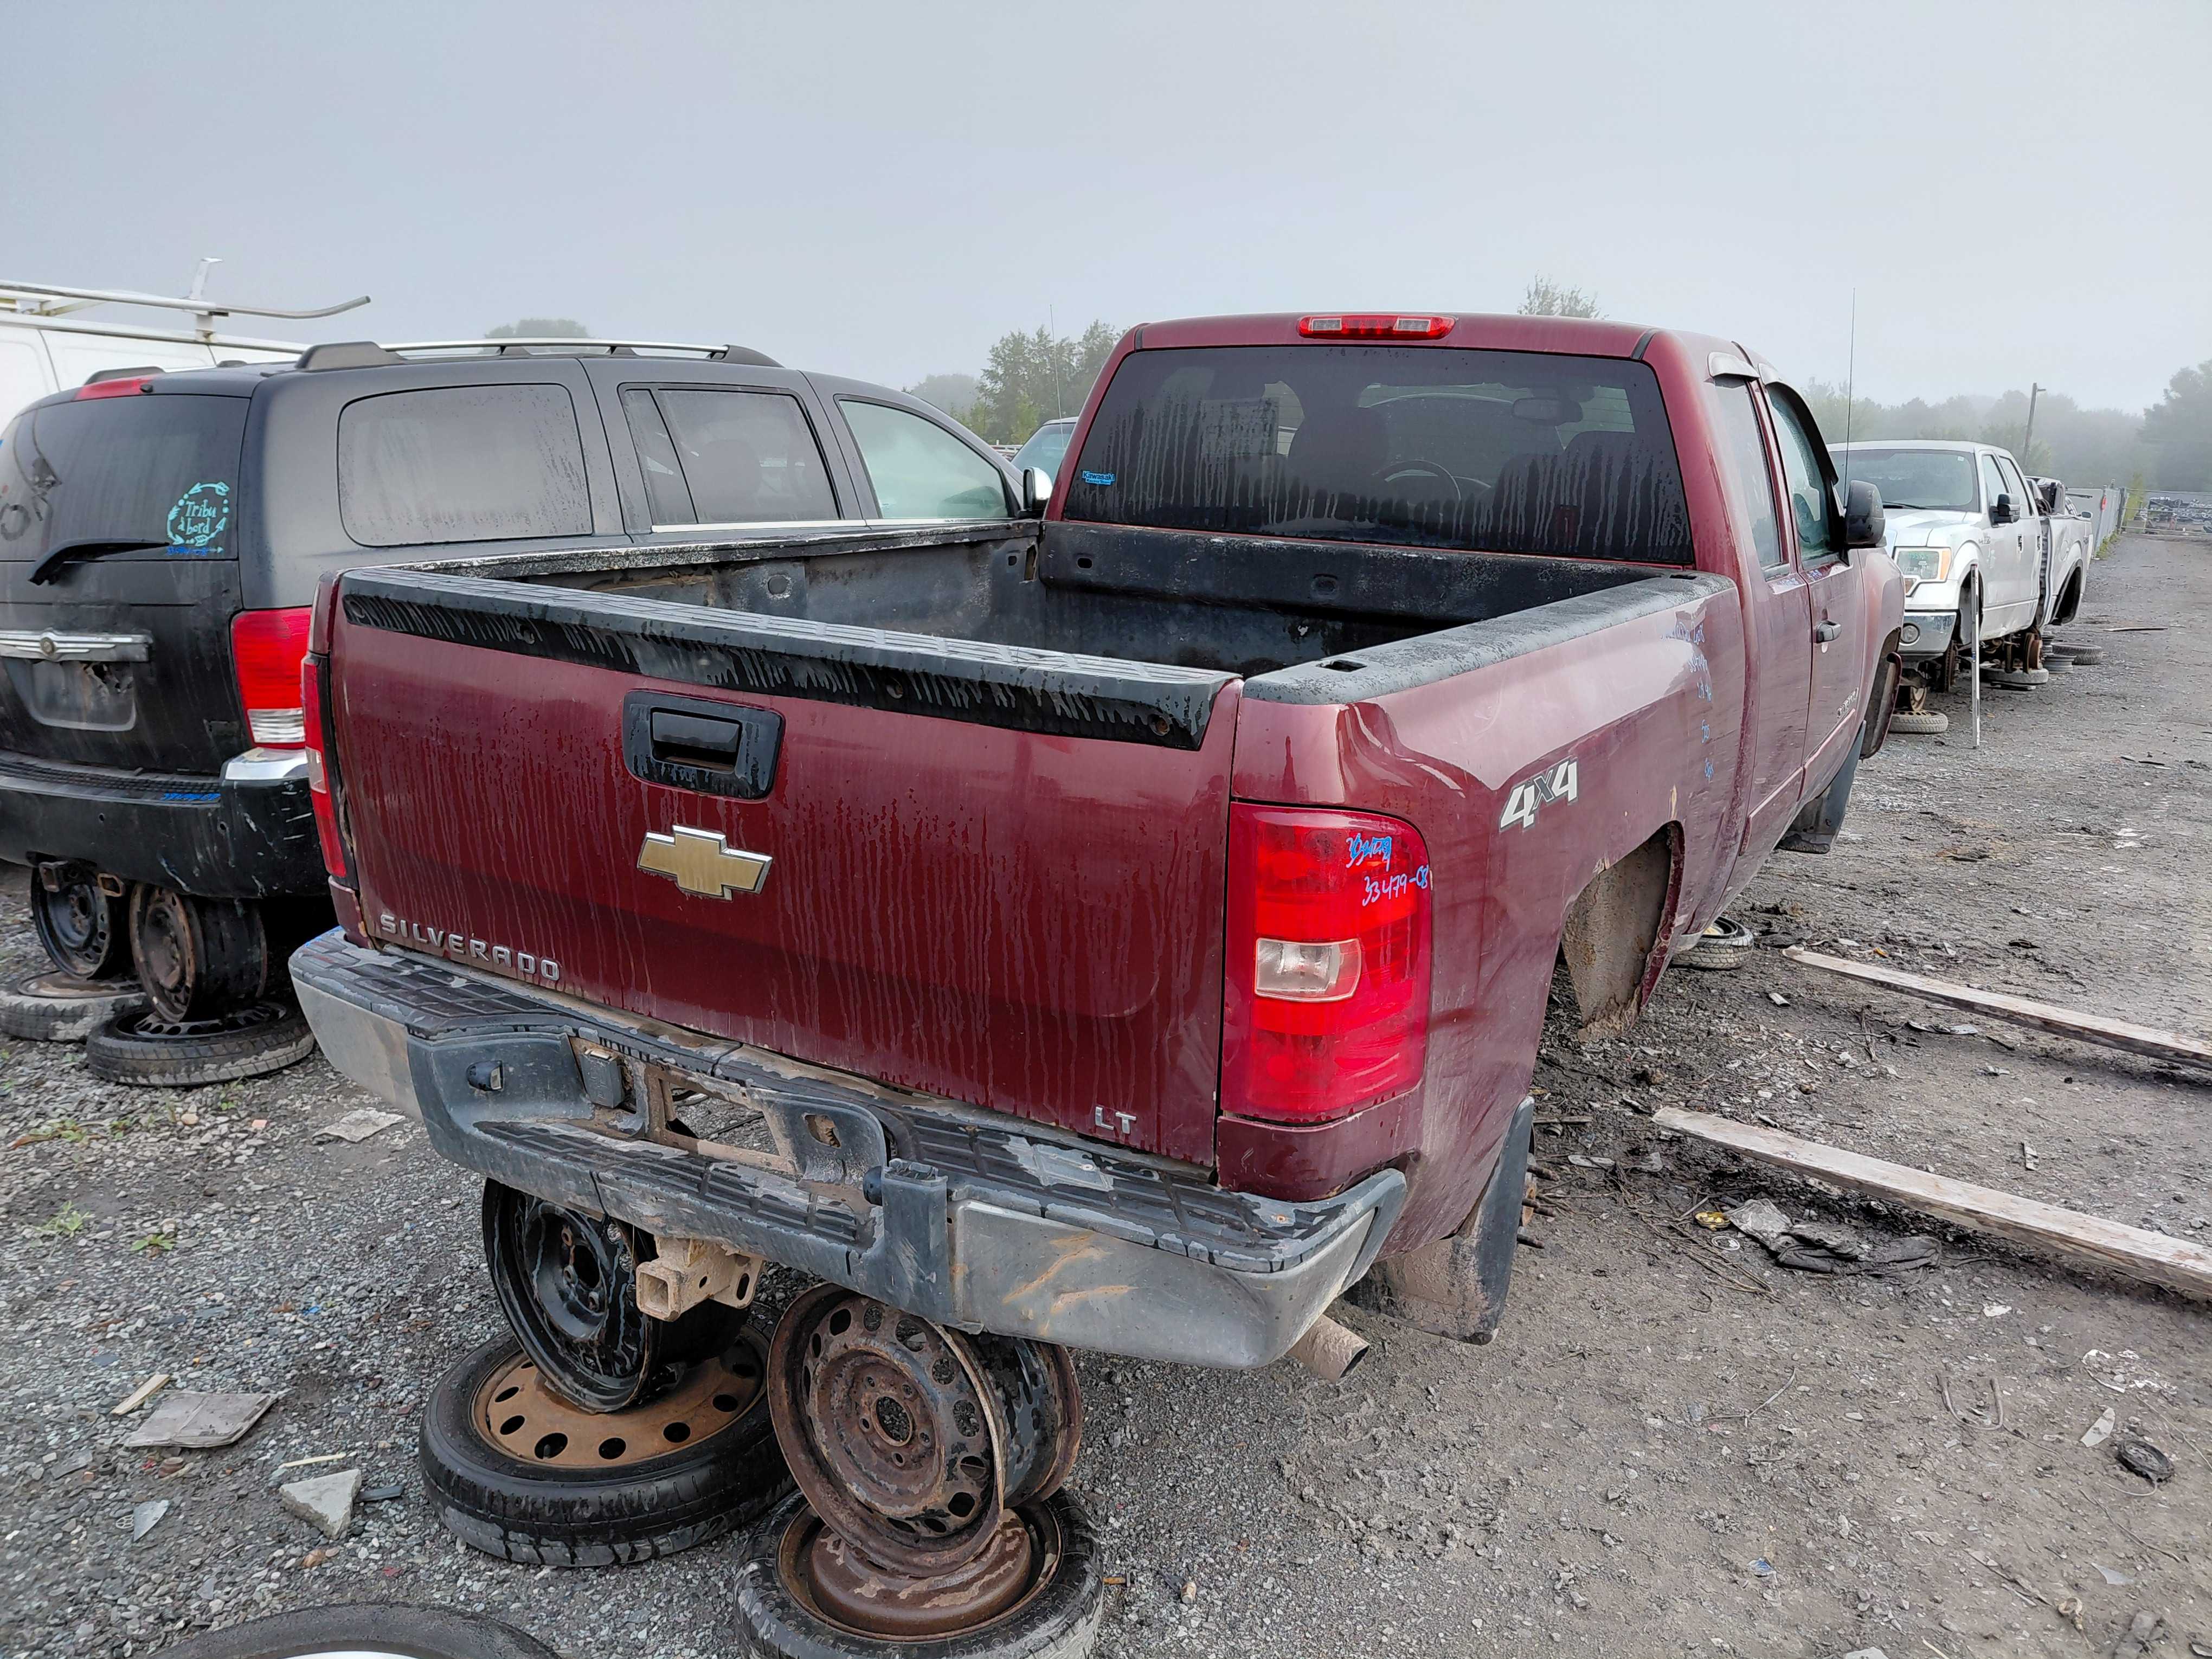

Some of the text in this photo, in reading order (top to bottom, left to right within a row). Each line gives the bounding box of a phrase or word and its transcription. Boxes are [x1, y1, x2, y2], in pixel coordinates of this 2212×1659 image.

[1083, 471, 1115, 481] Kawasaki
[185, 499, 217, 518] Tribu
[185, 517, 210, 535] bord
[381, 914, 560, 981] SILVERADO
[1095, 1106, 1137, 1134] LT
